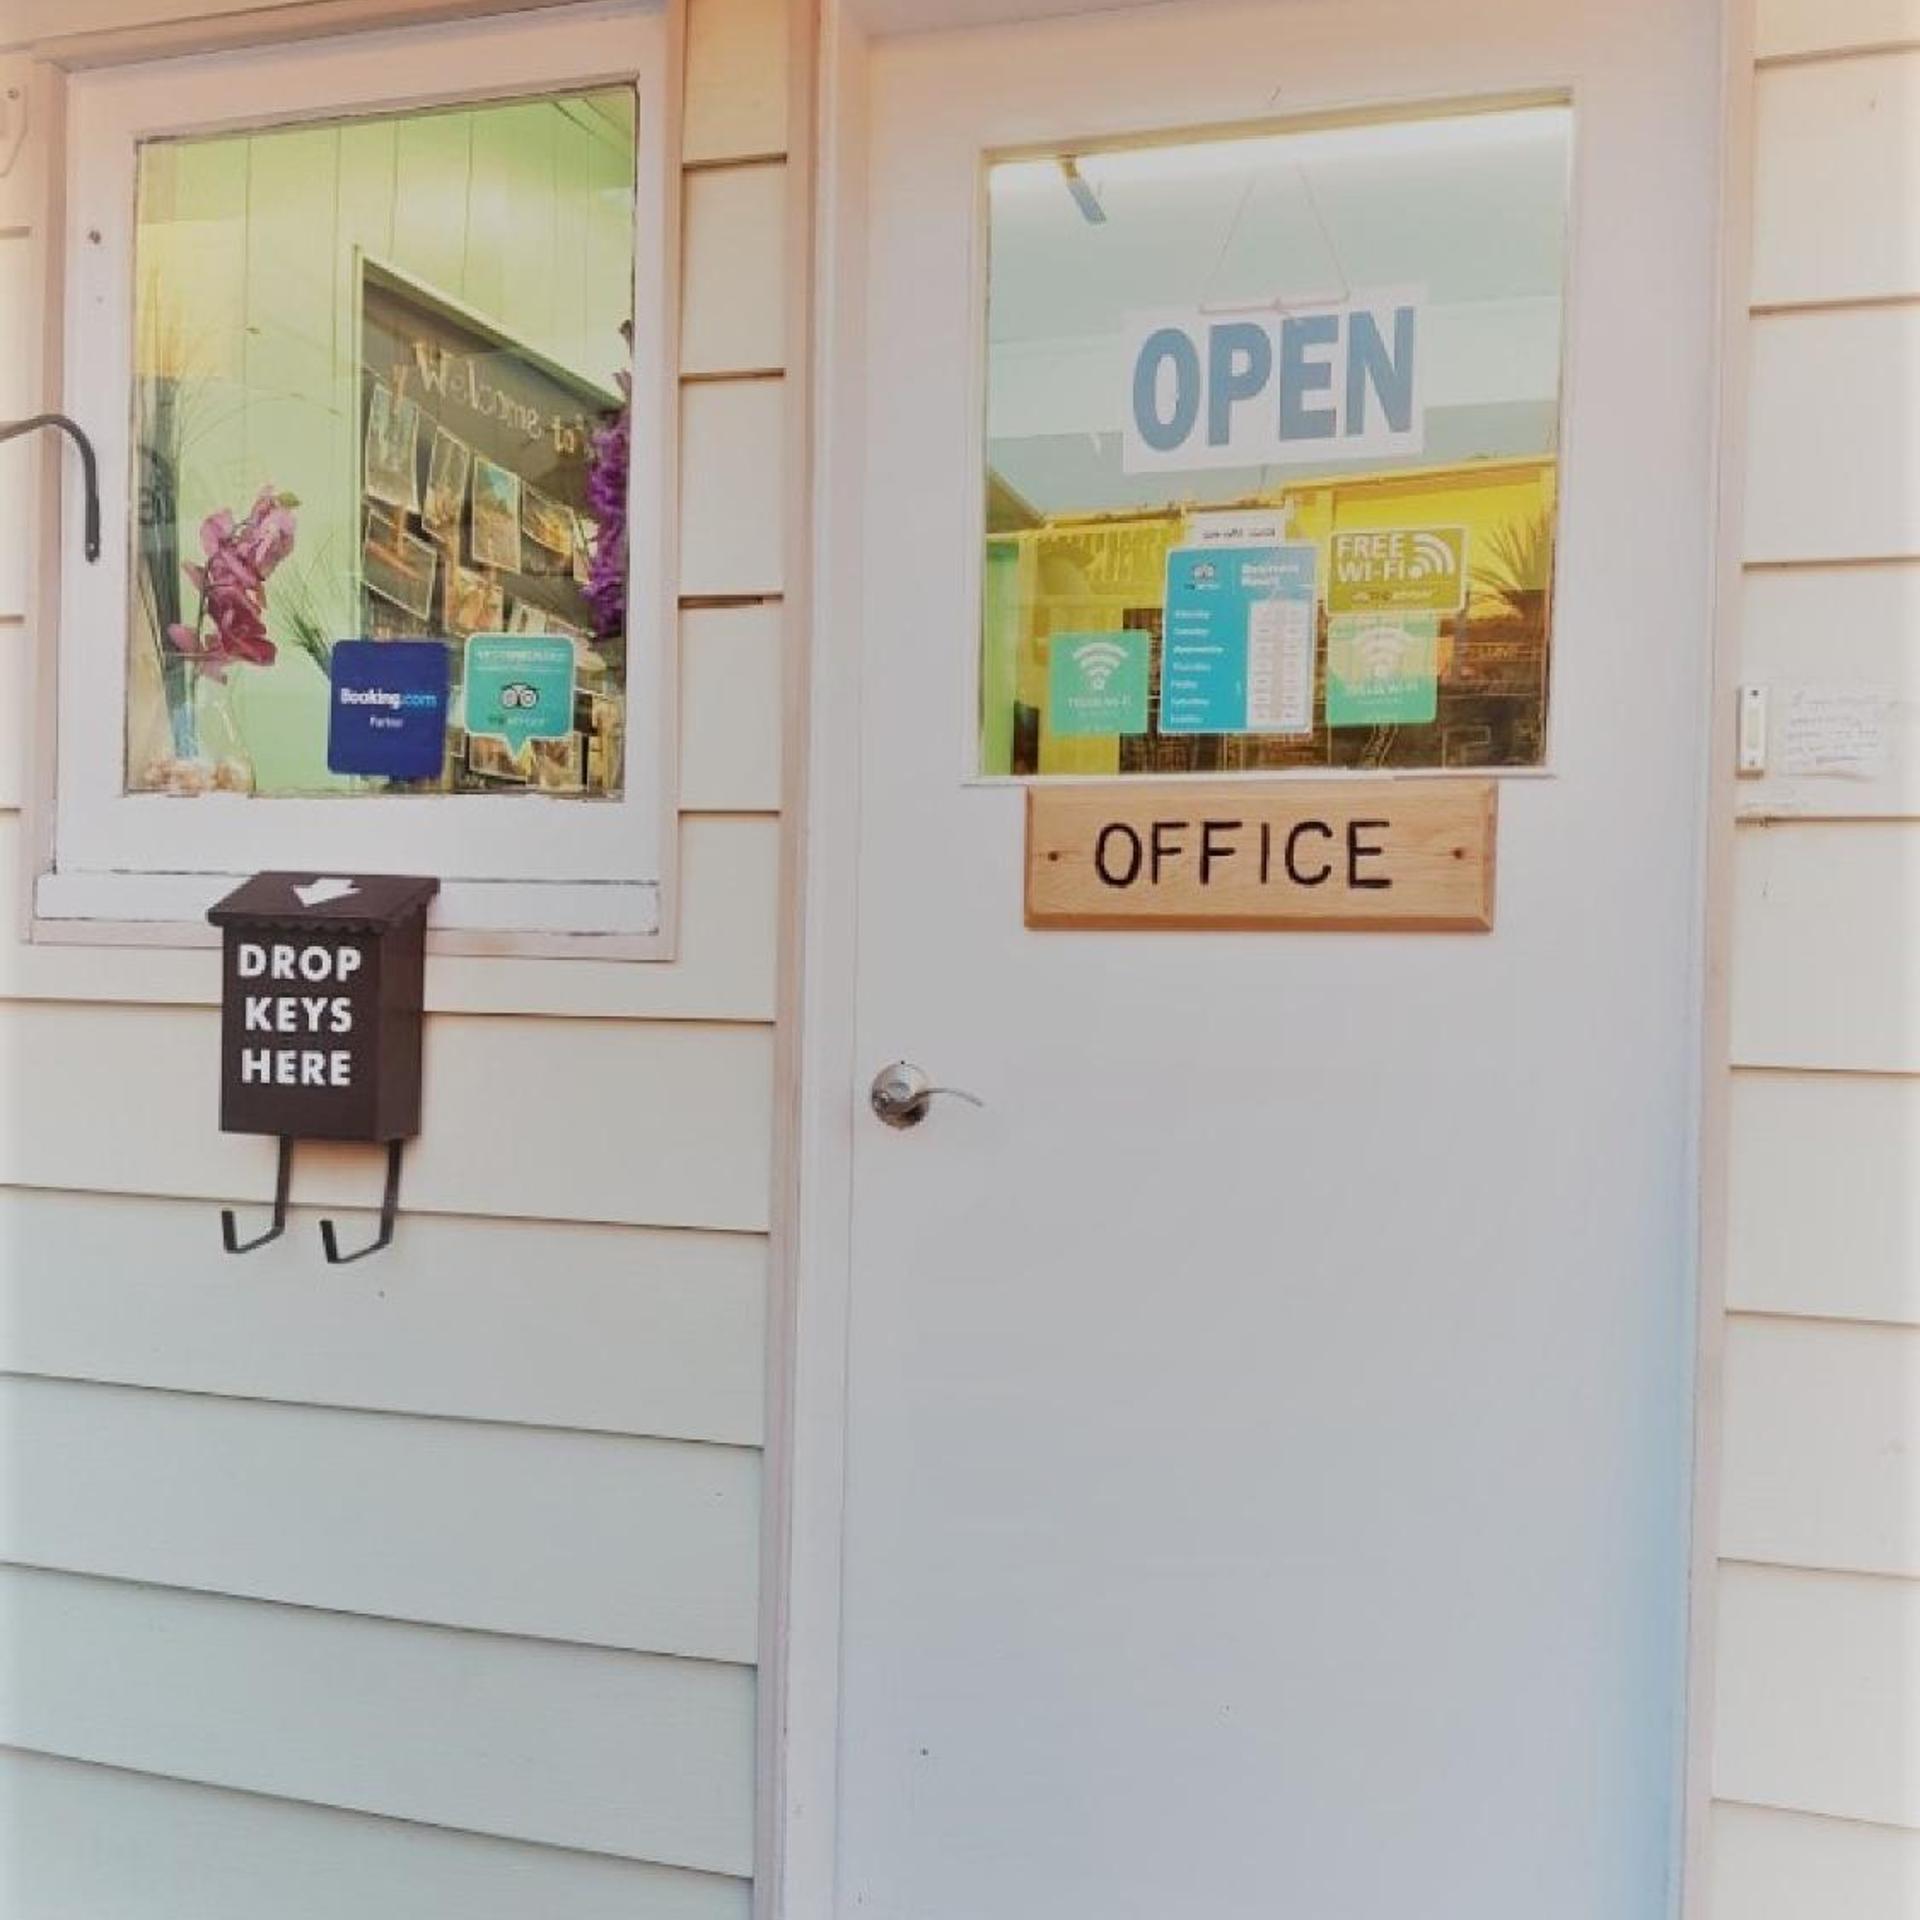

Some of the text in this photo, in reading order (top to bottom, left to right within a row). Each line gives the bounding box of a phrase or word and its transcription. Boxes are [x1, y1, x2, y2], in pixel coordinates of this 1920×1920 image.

[412, 343, 543, 440] Welcome
[1132, 306, 1416, 453] OPEN
[1337, 533, 1405, 560] FREE
[1338, 559, 1405, 582] WI-FI
[340, 687, 438, 711] Booking.com
[1095, 820, 1393, 890] OFFICE
[237, 943, 362, 982] DROP
[244, 996, 353, 1033] KEYS
[241, 1049, 352, 1087] HERE
